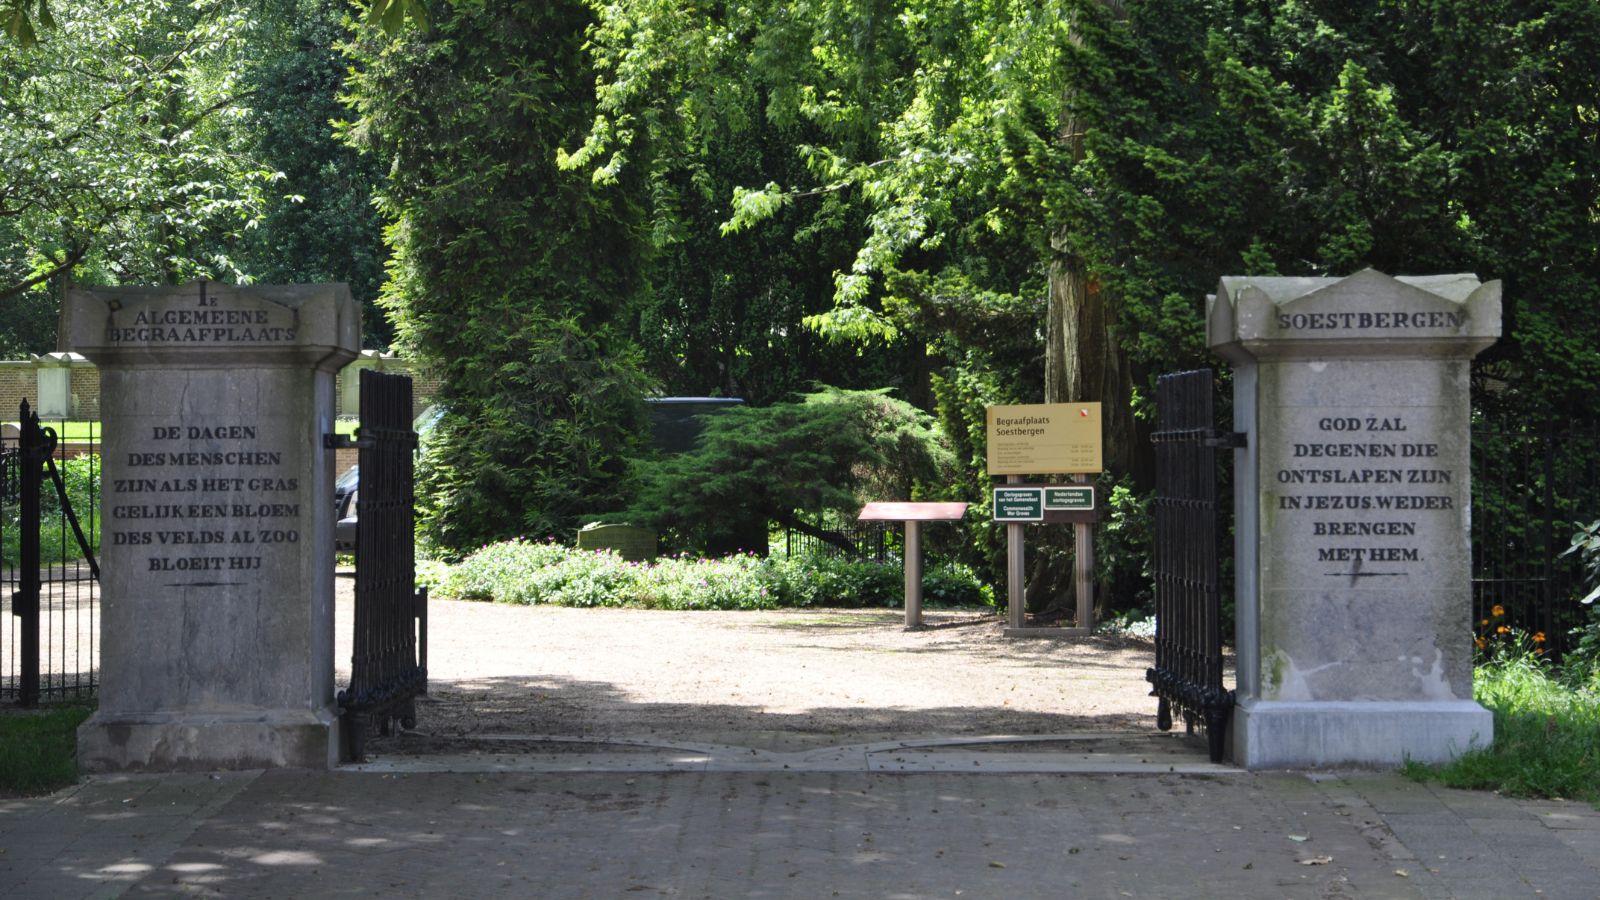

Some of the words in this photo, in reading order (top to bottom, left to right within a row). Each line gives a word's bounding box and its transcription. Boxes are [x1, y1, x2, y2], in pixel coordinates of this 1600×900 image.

[134, 310, 269, 325] ALGEMEENE
[1278, 312, 1465, 329] SOESTBERGEN
[110, 327, 297, 342] BEGRAAFPLAATS
[996, 416, 1050, 426] Begraafplaats
[1319, 418, 1361, 431] GOD
[1366, 418, 1407, 431] ZAL
[153, 427, 181, 440] DE
[187, 426, 256, 440] DAGEN
[996, 428, 1045, 436] Soestbergen
[1293, 444, 1397, 457] DEGENEN
[1401, 444, 1439, 457] DIE
[128, 453, 166, 467] DES
[169, 452, 282, 466] MENSCHEN
[1277, 470, 1403, 483] ONTSLAPEN
[1407, 470, 1452, 483] ZIJN
[114, 479, 157, 493] ZIJN
[160, 479, 198, 492] ALS
[201, 478, 245, 492] HET
[248, 478, 299, 491] GRAS
[1279, 496, 1301, 509] IN
[113, 505, 184, 519] GELIJK
[188, 505, 228, 518] EEN
[231, 504, 300, 517] BLOEM
[1313, 522, 1416, 536] BRENGEN
[113, 531, 152, 545] DES
[231, 531, 255, 543] AL
[259, 530, 299, 543] ZOO
[1318, 548, 1366, 561] MET
[1369, 548, 1425, 561] HEM.
[148, 557, 225, 571] BLOEIT
[228, 557, 262, 570] HIJ
